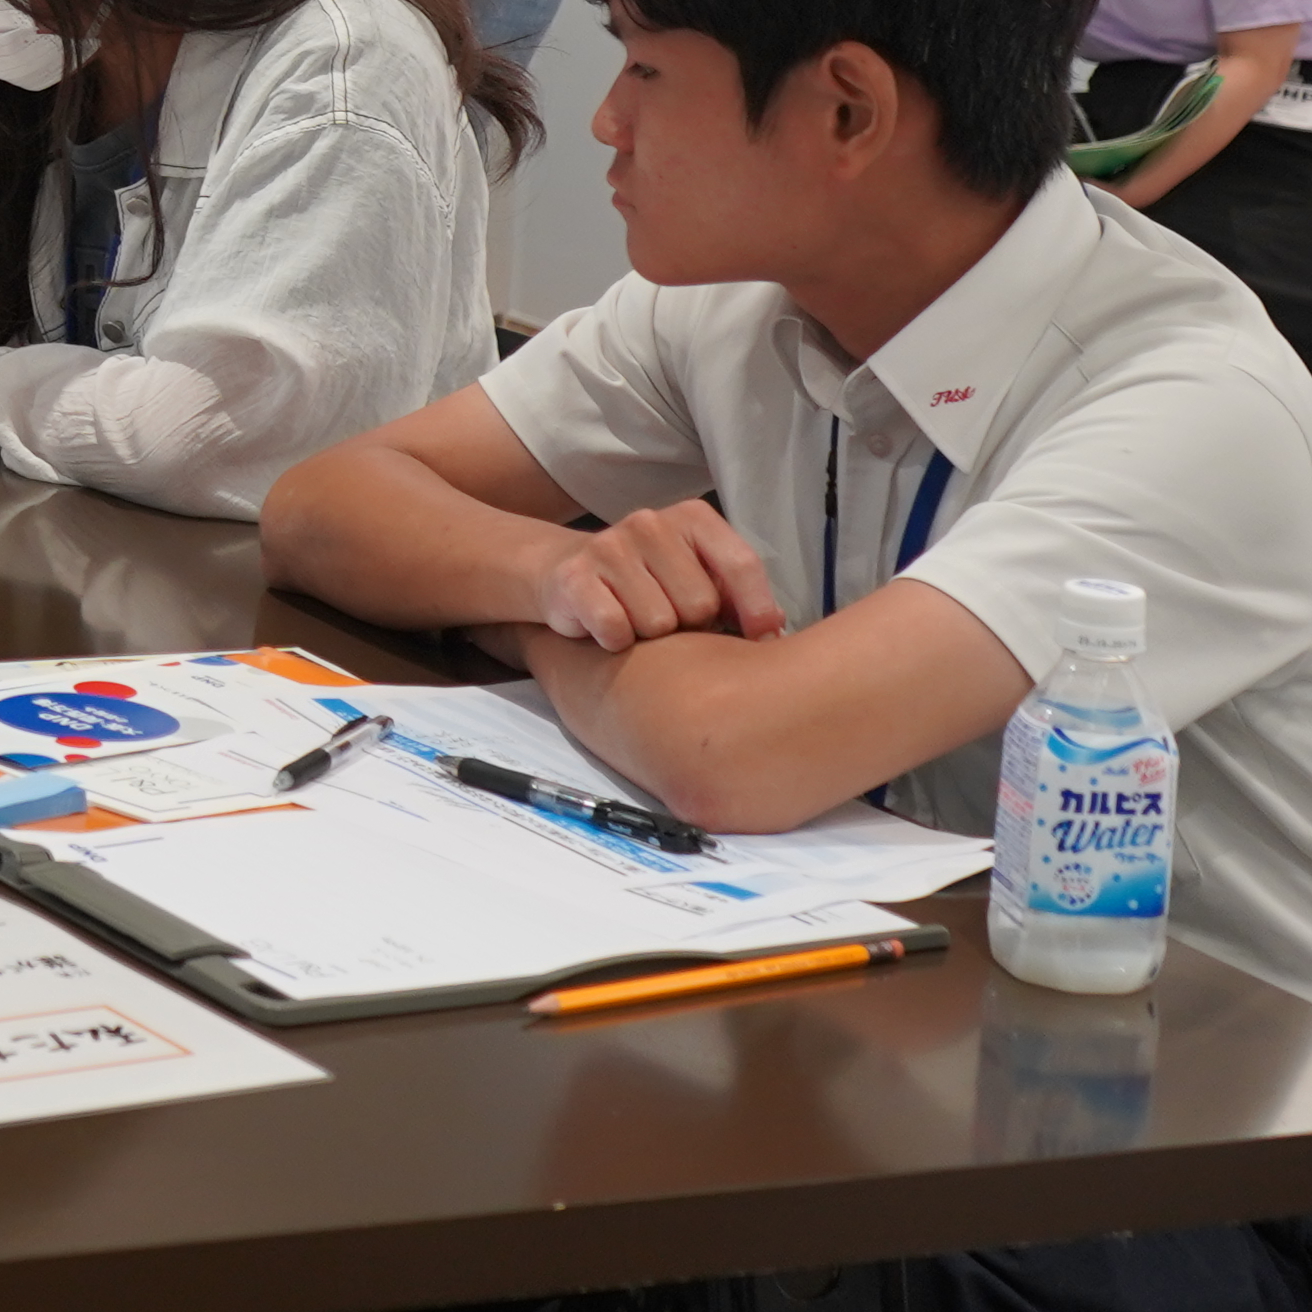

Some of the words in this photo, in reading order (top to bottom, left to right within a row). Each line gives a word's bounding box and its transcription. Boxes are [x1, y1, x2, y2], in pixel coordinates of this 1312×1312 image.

[191, 675, 225, 688] DNP
[38, 712, 94, 731] DNP
[1060, 788, 1163, 816] カルピス
[1051, 818, 1164, 854] Water
[68, 843, 109, 863] DNP
